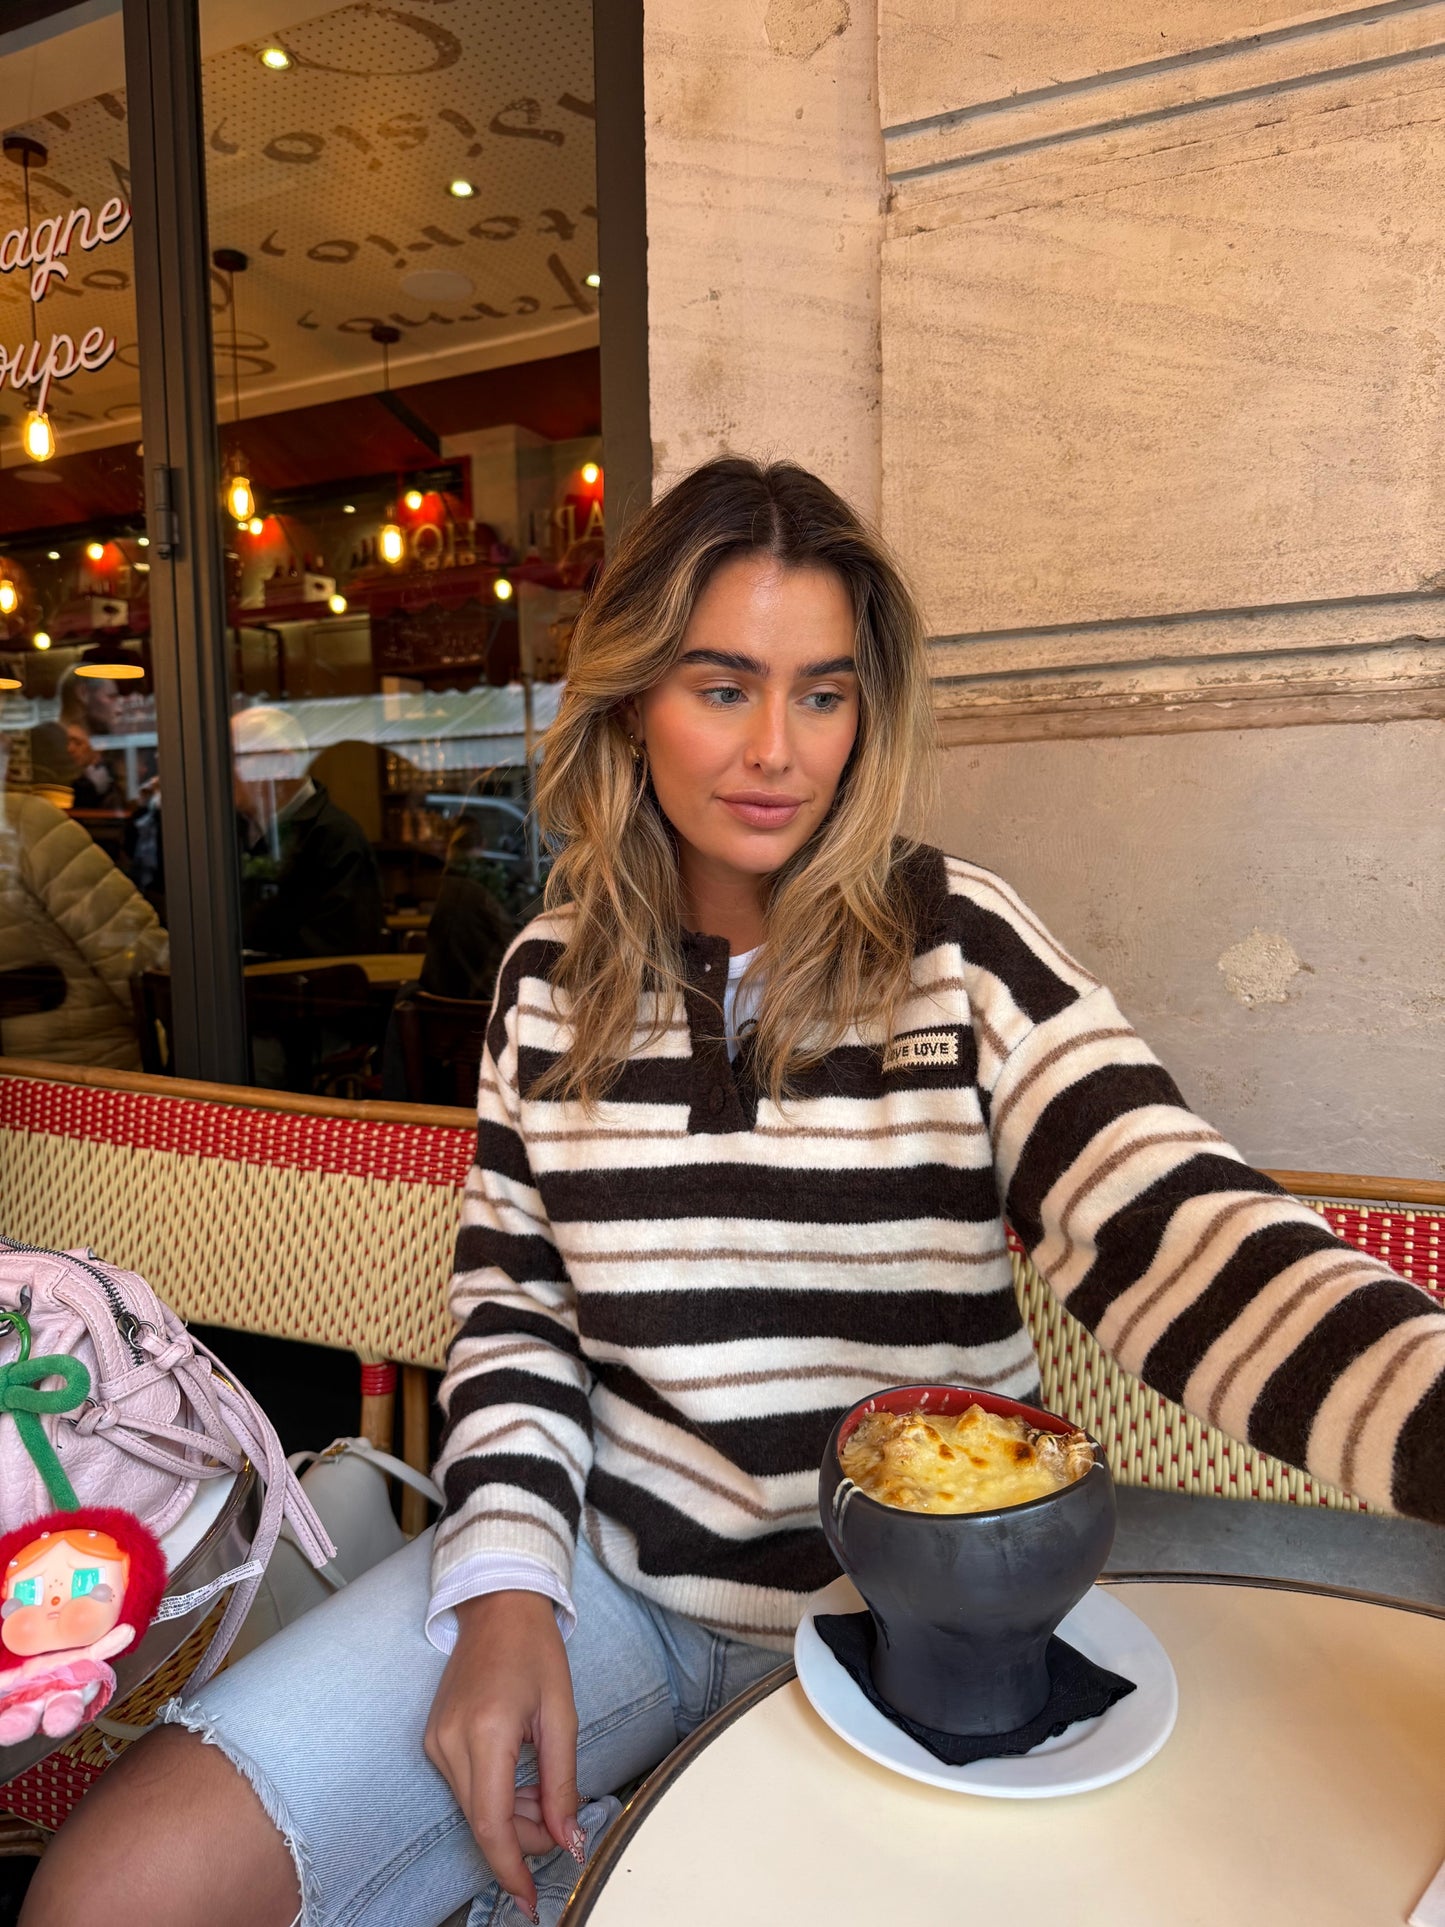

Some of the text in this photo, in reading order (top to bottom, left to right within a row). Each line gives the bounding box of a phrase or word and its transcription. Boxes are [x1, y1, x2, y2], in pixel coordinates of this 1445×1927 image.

[0, 197, 132, 302] agne
[260, 205, 599, 269] torio,
[914, 1042, 949, 1057] LOVE
